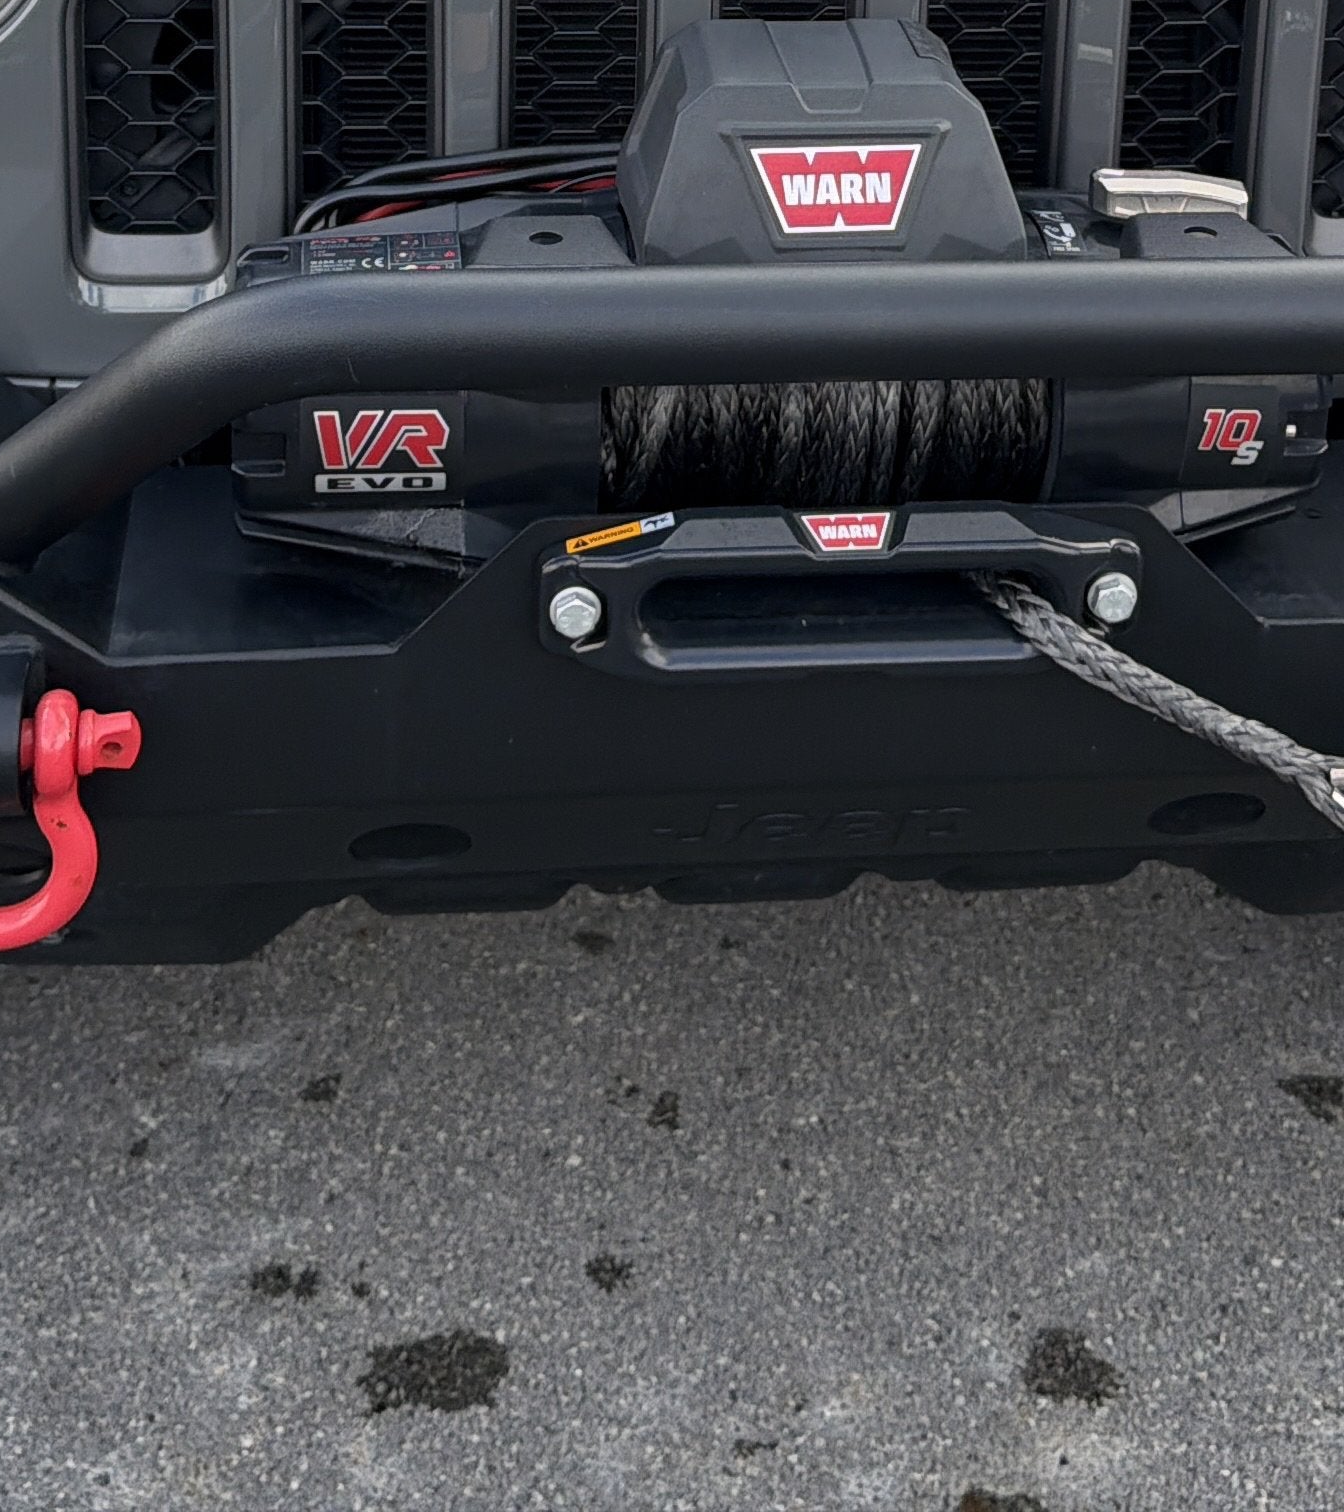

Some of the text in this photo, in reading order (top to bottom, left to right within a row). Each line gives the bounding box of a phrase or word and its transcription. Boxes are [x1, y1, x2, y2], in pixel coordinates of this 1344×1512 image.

[781, 172, 892, 206] WARN
[313, 409, 450, 469] VR
[327, 476, 433, 490] EVO
[588, 526, 635, 544] WARNING
[818, 523, 878, 540] WARN
[652, 803, 969, 850] Jeep
